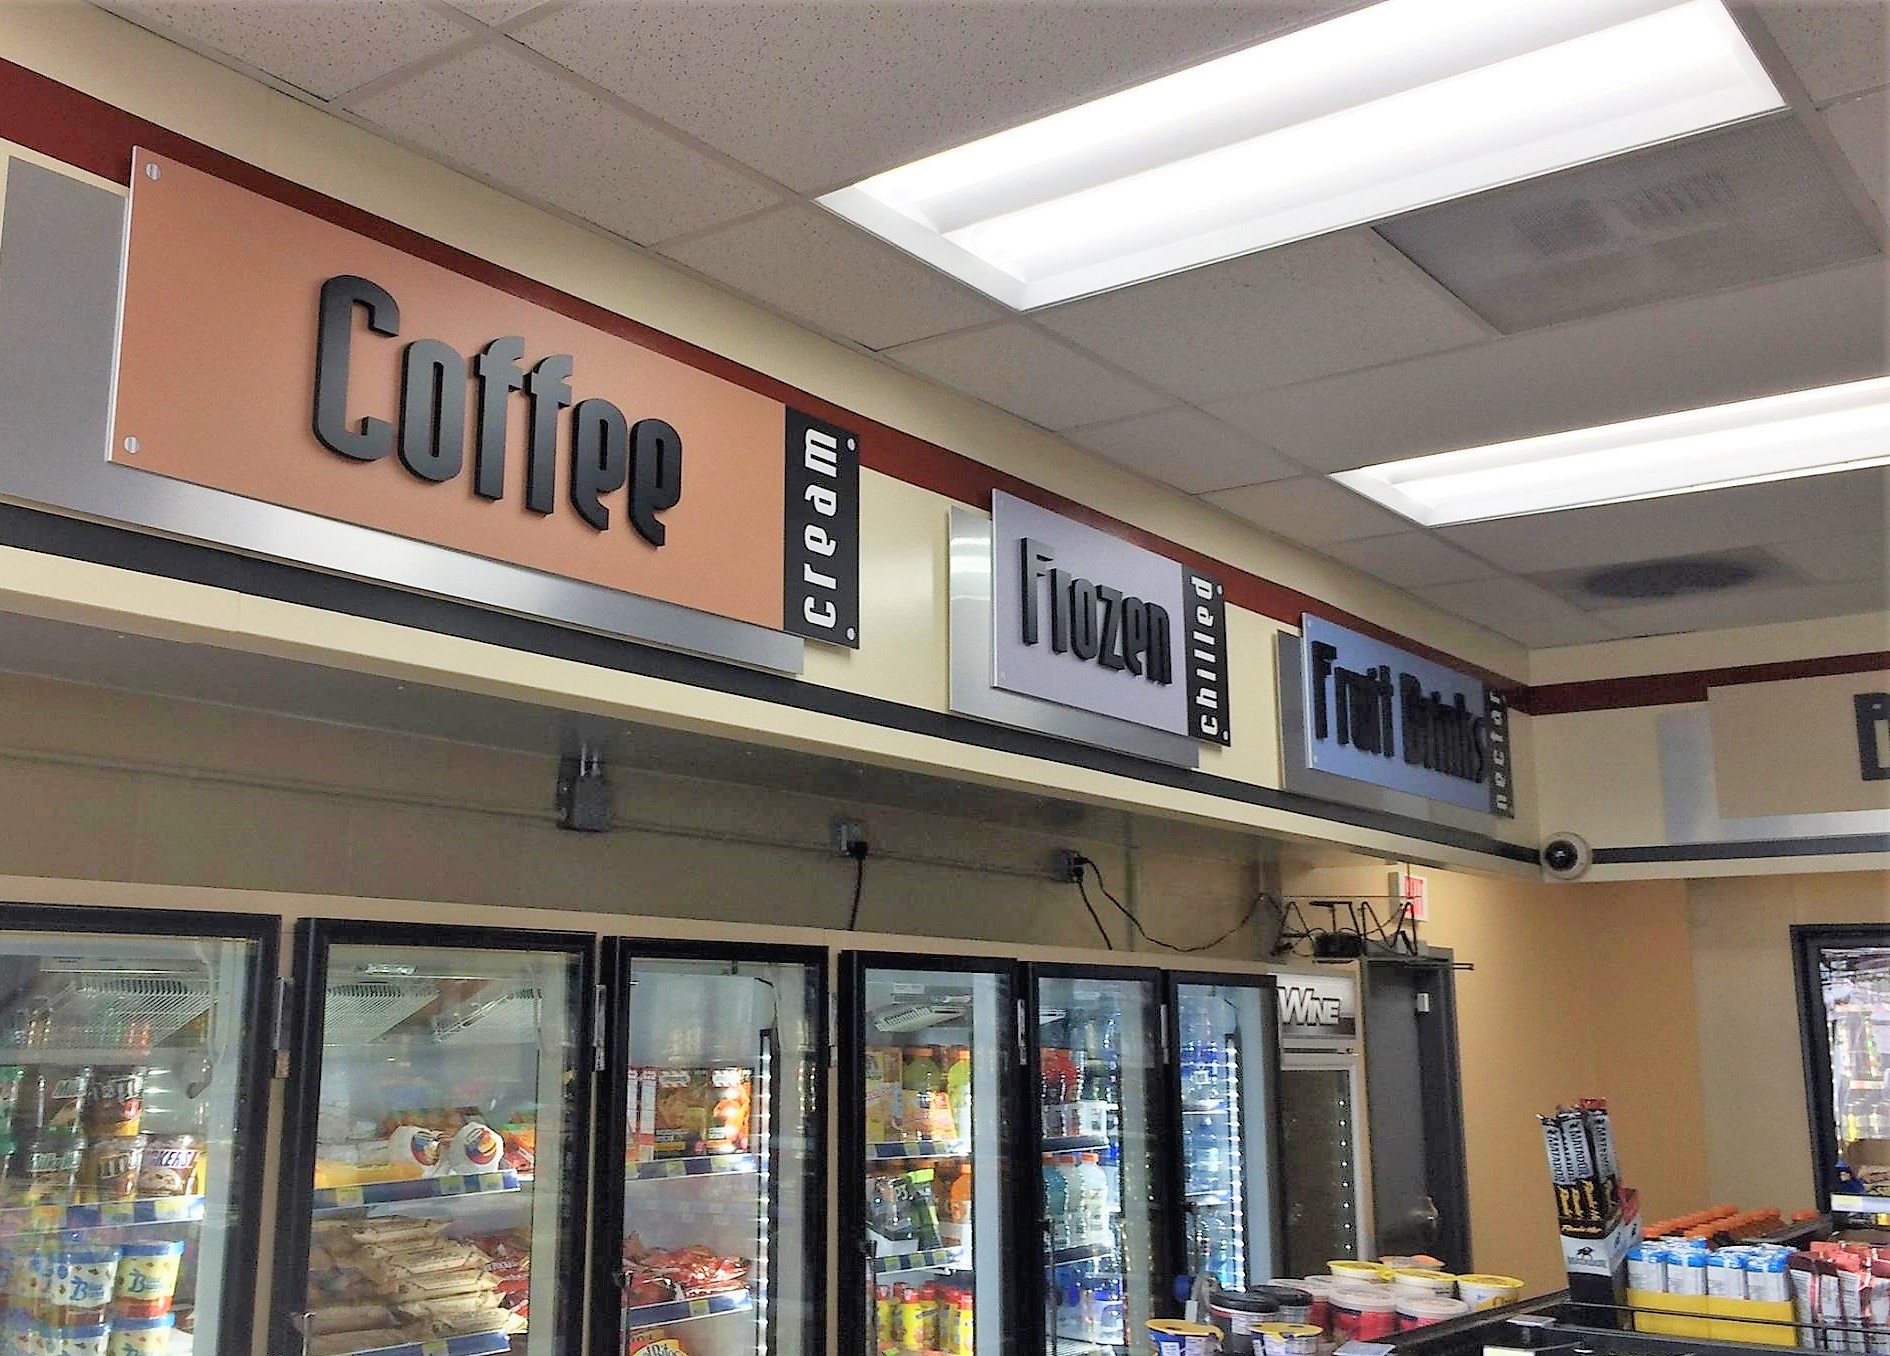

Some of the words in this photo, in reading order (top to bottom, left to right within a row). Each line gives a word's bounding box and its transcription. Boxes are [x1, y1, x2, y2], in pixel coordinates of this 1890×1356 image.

[313, 274, 683, 547] Coffee
[802, 426, 839, 630] cream
[1020, 537, 1173, 686] Frozen
[1190, 575, 1219, 737] chilled
[1311, 641, 1395, 758] Fruit
[1487, 689, 1508, 812] nectar
